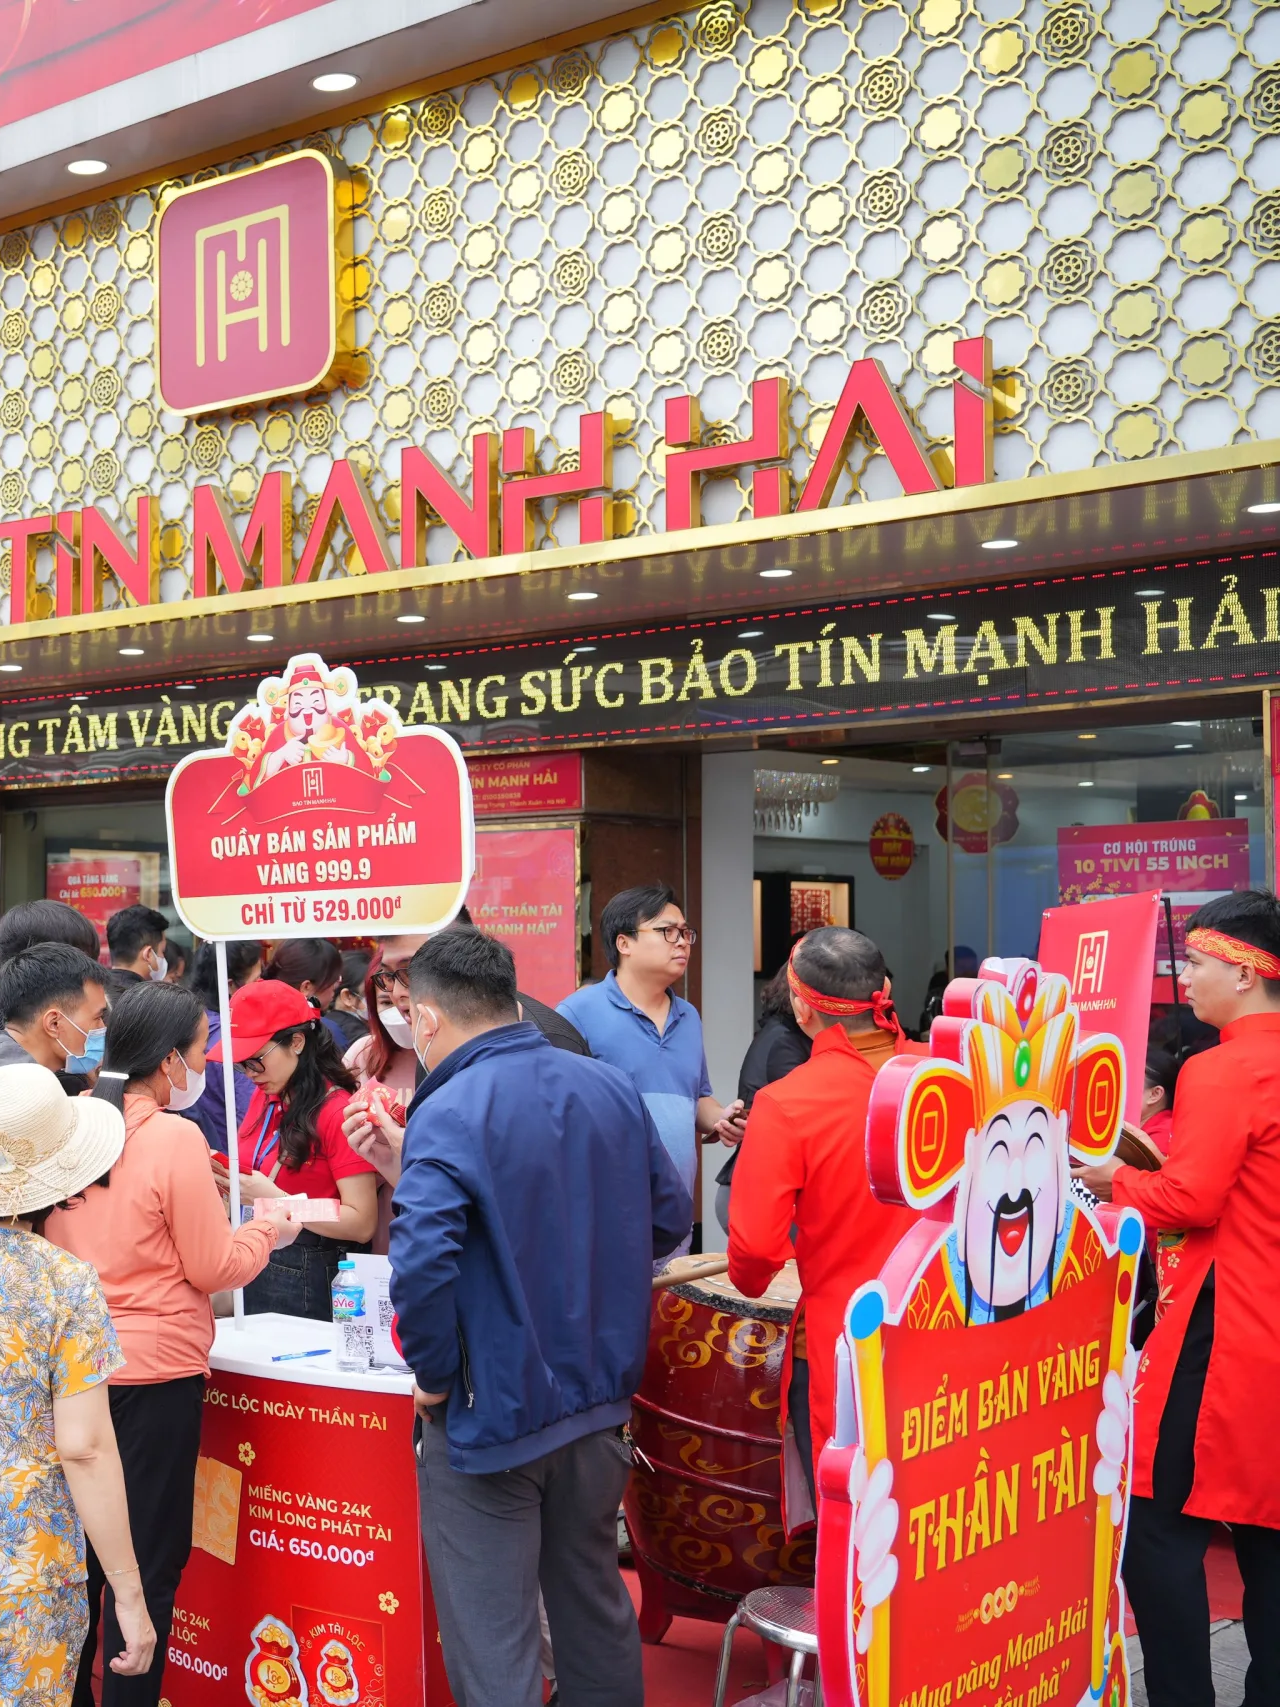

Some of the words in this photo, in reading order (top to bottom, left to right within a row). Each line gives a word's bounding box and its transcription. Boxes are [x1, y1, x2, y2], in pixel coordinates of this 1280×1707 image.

[38, 705, 120, 756] TÂM
[126, 695, 236, 748] VÀNG
[520, 653, 624, 716] SỨC
[638, 638, 757, 706] BẢO
[775, 622, 882, 691] TÍN
[902, 605, 1116, 686] MẠNH
[1141, 574, 1280, 655] HẢI
[470, 775, 484, 788] ÍN
[488, 774, 529, 790] MẠNH
[533, 768, 558, 785] HẢI
[211, 827, 261, 860] QUẦY
[267, 826, 306, 855] BÁN
[312, 822, 350, 851] SẢN
[357, 812, 417, 847] PHẨM
[1103, 841, 1121, 855] CƠ
[1125, 839, 1148, 856] HỘI
[1152, 837, 1196, 853] TRÚNG
[256, 859, 310, 886] VÀNG
[315, 858, 371, 883] 999.9
[1074, 859, 1095, 874] 10
[1100, 858, 1140, 873] TIVI
[1146, 856, 1170, 872] 55
[1176, 853, 1229, 870] INCH
[241, 896, 275, 925] CHỈ
[281, 896, 307, 923] TỪ
[232, 1394, 259, 1414] LỘC
[264, 1401, 305, 1420] NGÀY
[308, 1406, 354, 1427] THẦN
[359, 1411, 387, 1430] TÀI
[901, 1373, 968, 1461] ĐIỂM
[977, 1361, 1029, 1431] BÁN
[1037, 1340, 1100, 1405] VÀNG
[248, 1484, 292, 1505] MIẾNG
[295, 1492, 337, 1513] VÀNG
[341, 1501, 372, 1518] 24K
[908, 1446, 1020, 1581] THẦN
[1032, 1425, 1088, 1523] TÀI
[248, 1504, 273, 1521] KIM
[277, 1510, 316, 1529] LONG
[321, 1518, 362, 1537] PHÁT
[365, 1524, 392, 1541] TÀI
[249, 1529, 284, 1552] GIÁ:
[177, 1626, 197, 1645] LỘC
[189, 1612, 210, 1631] 24K
[309, 1623, 326, 1639] KIM
[328, 1622, 345, 1636] TÀI
[346, 1630, 365, 1651] LỘC
[956, 1660, 1002, 1699] vàng
[1004, 1618, 1055, 1673] Mạnh
[1058, 1597, 1089, 1643] Hải
